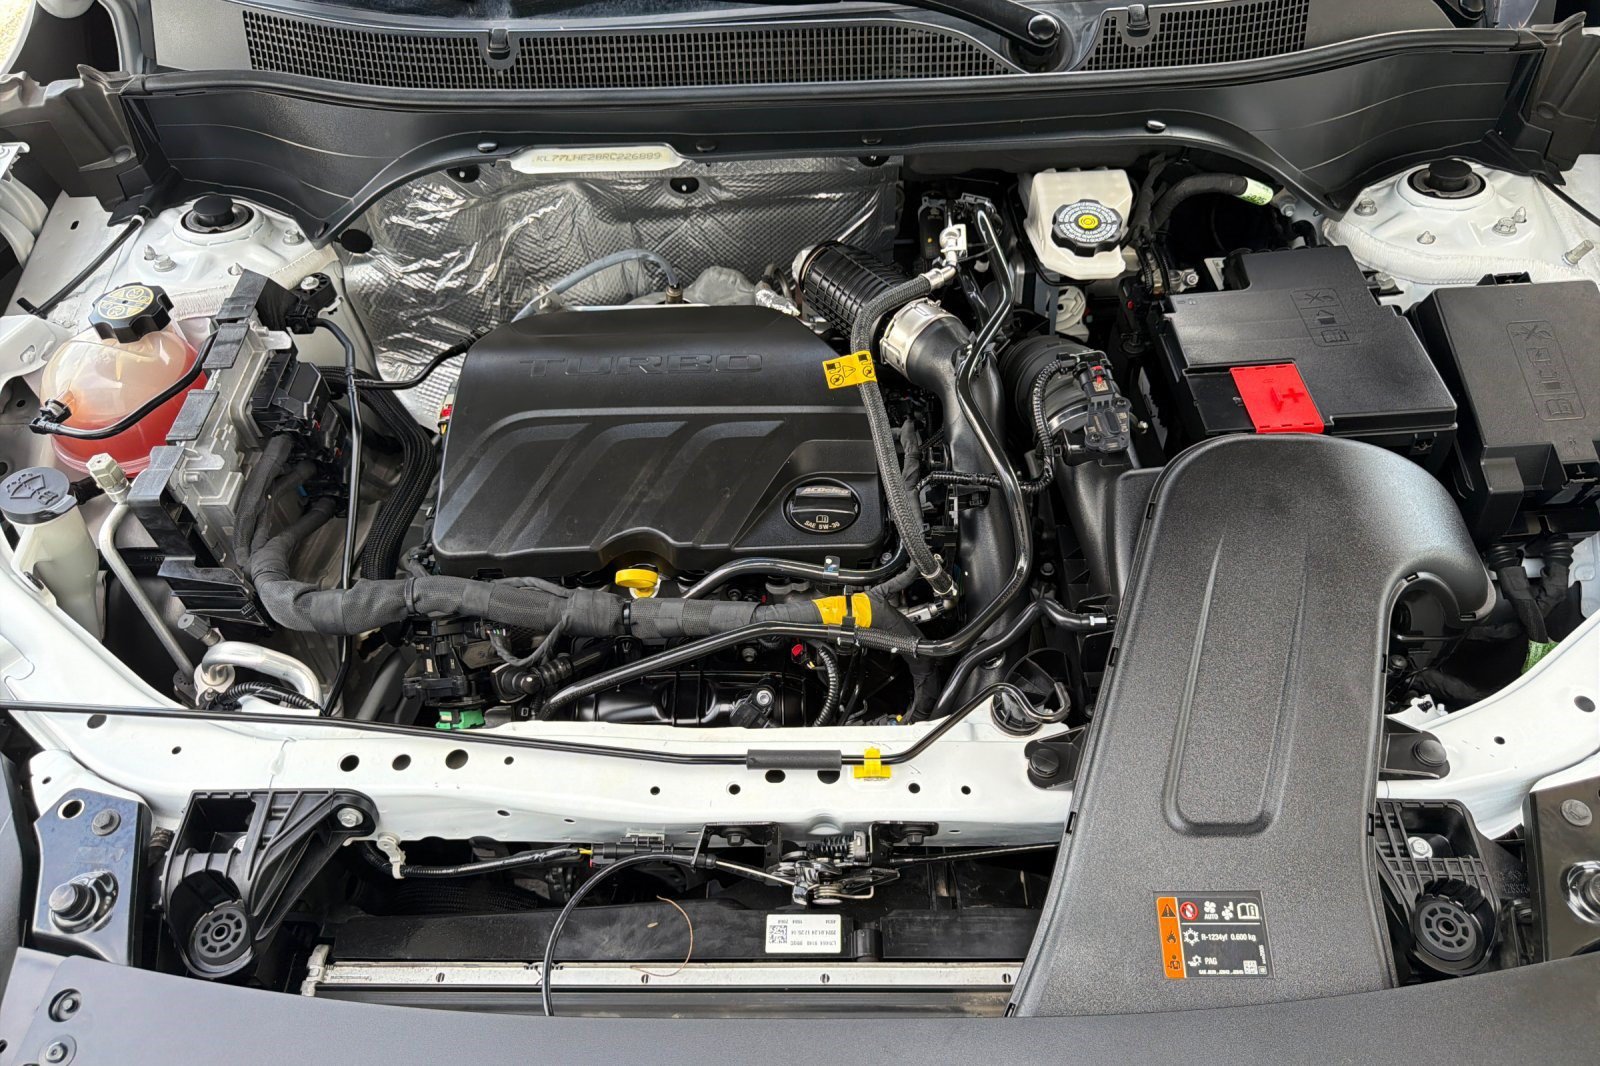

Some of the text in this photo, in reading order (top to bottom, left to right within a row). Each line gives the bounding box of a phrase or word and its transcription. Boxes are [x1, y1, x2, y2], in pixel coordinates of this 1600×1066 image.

[519, 353, 763, 377] TURBO
[804, 520, 841, 530] SAE 5W-30
[1200, 933, 1257, 942] R-1234yf 0.600 kg
[1204, 956, 1218, 965] PAG
